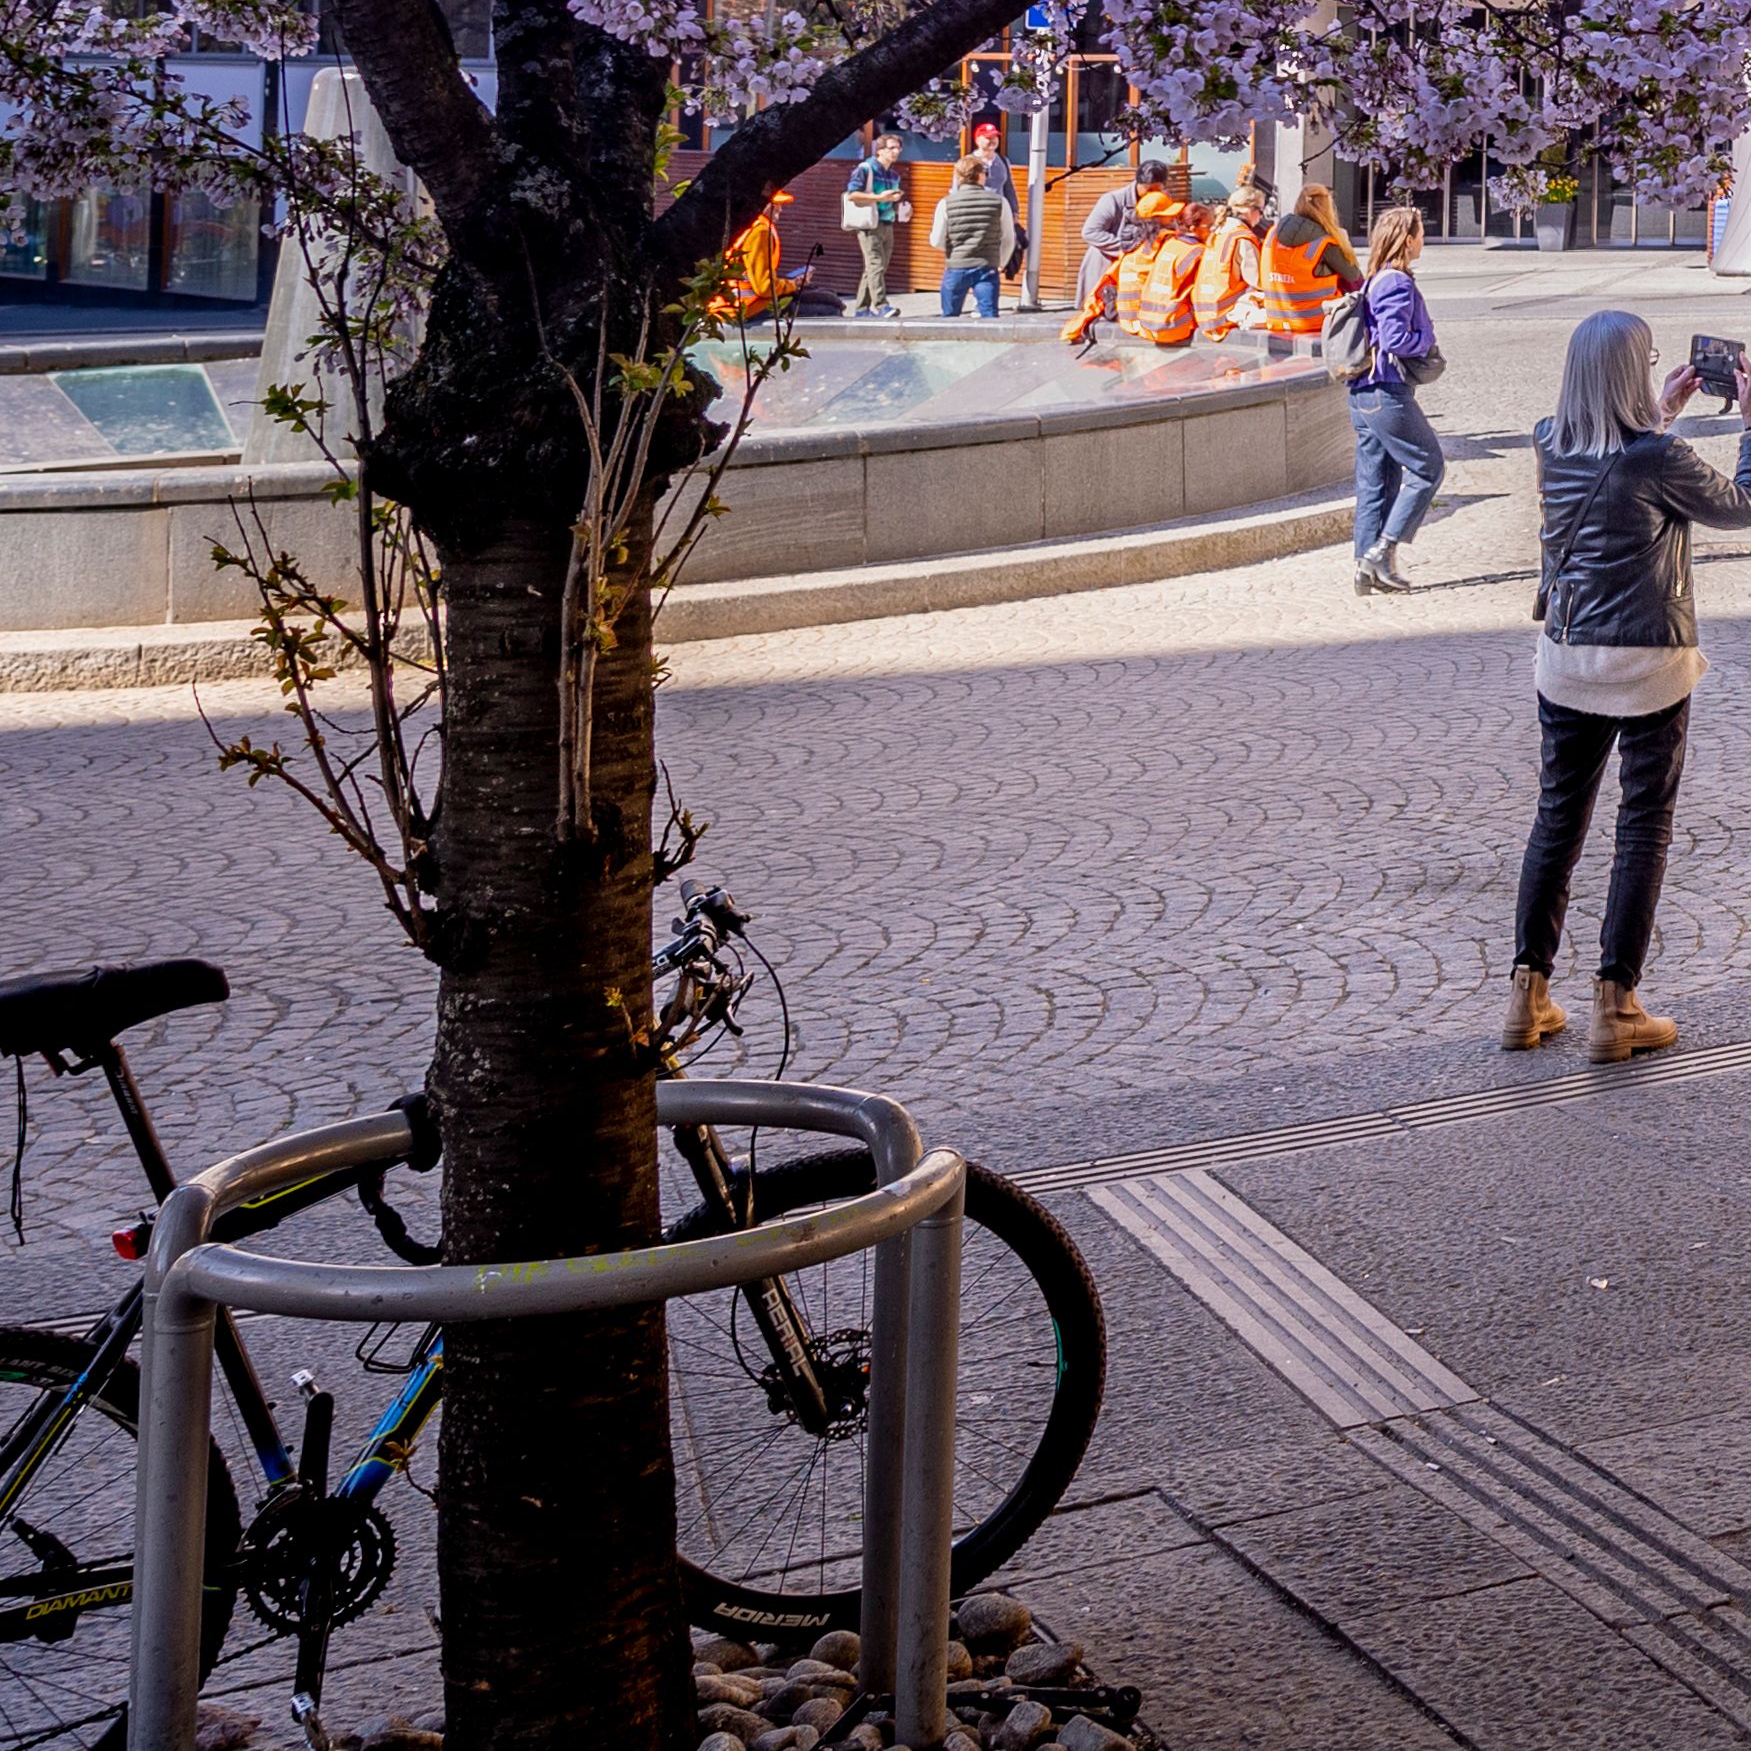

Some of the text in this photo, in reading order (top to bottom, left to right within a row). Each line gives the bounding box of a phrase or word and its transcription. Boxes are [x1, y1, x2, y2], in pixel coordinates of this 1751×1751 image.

[761, 1288, 808, 1378] AERIAL
[25, 1582, 133, 1621] DIAMANT
[712, 1601, 832, 1628] MERIDA
